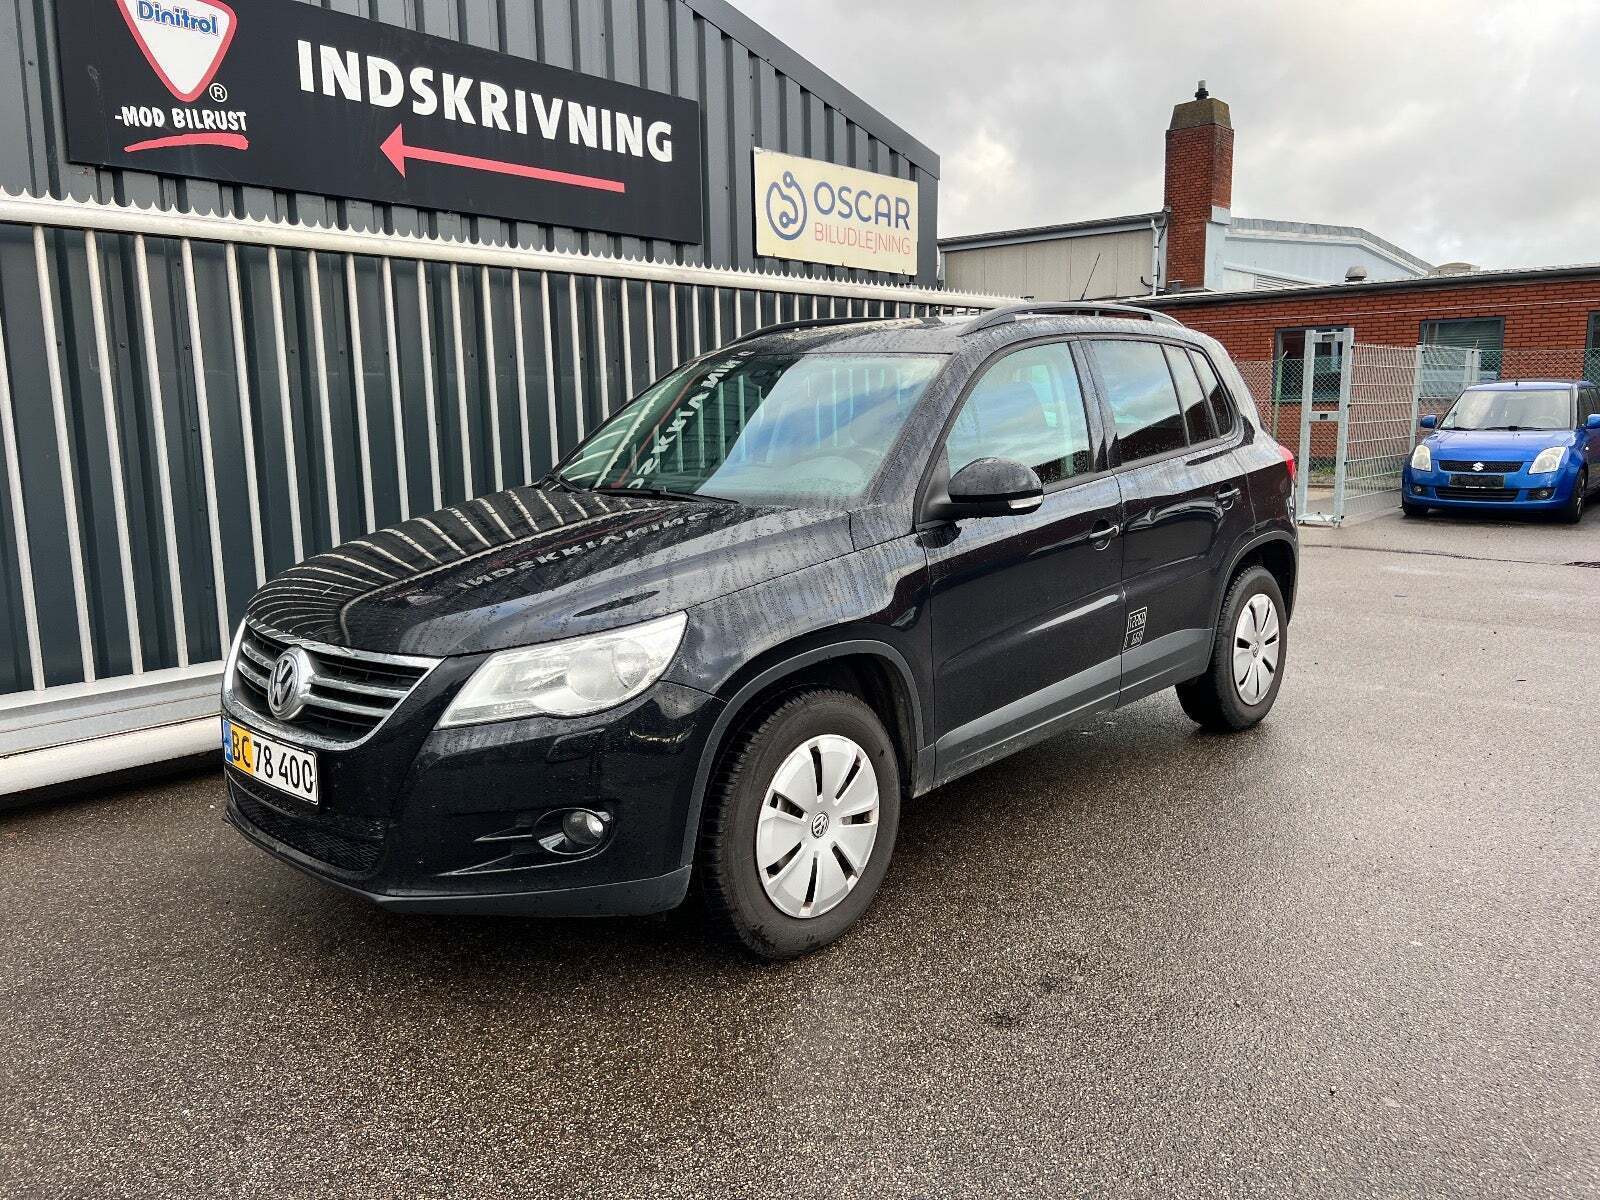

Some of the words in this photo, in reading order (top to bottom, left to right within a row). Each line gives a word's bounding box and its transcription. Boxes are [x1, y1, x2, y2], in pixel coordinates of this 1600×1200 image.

[137, 0, 218, 35] Dinitrol
[298, 40, 673, 162] INDSKRIVNING
[172, 108, 247, 131] BILRUST
[813, 181, 910, 231] OSCAR
[815, 222, 911, 255] BILUDLEJNING
